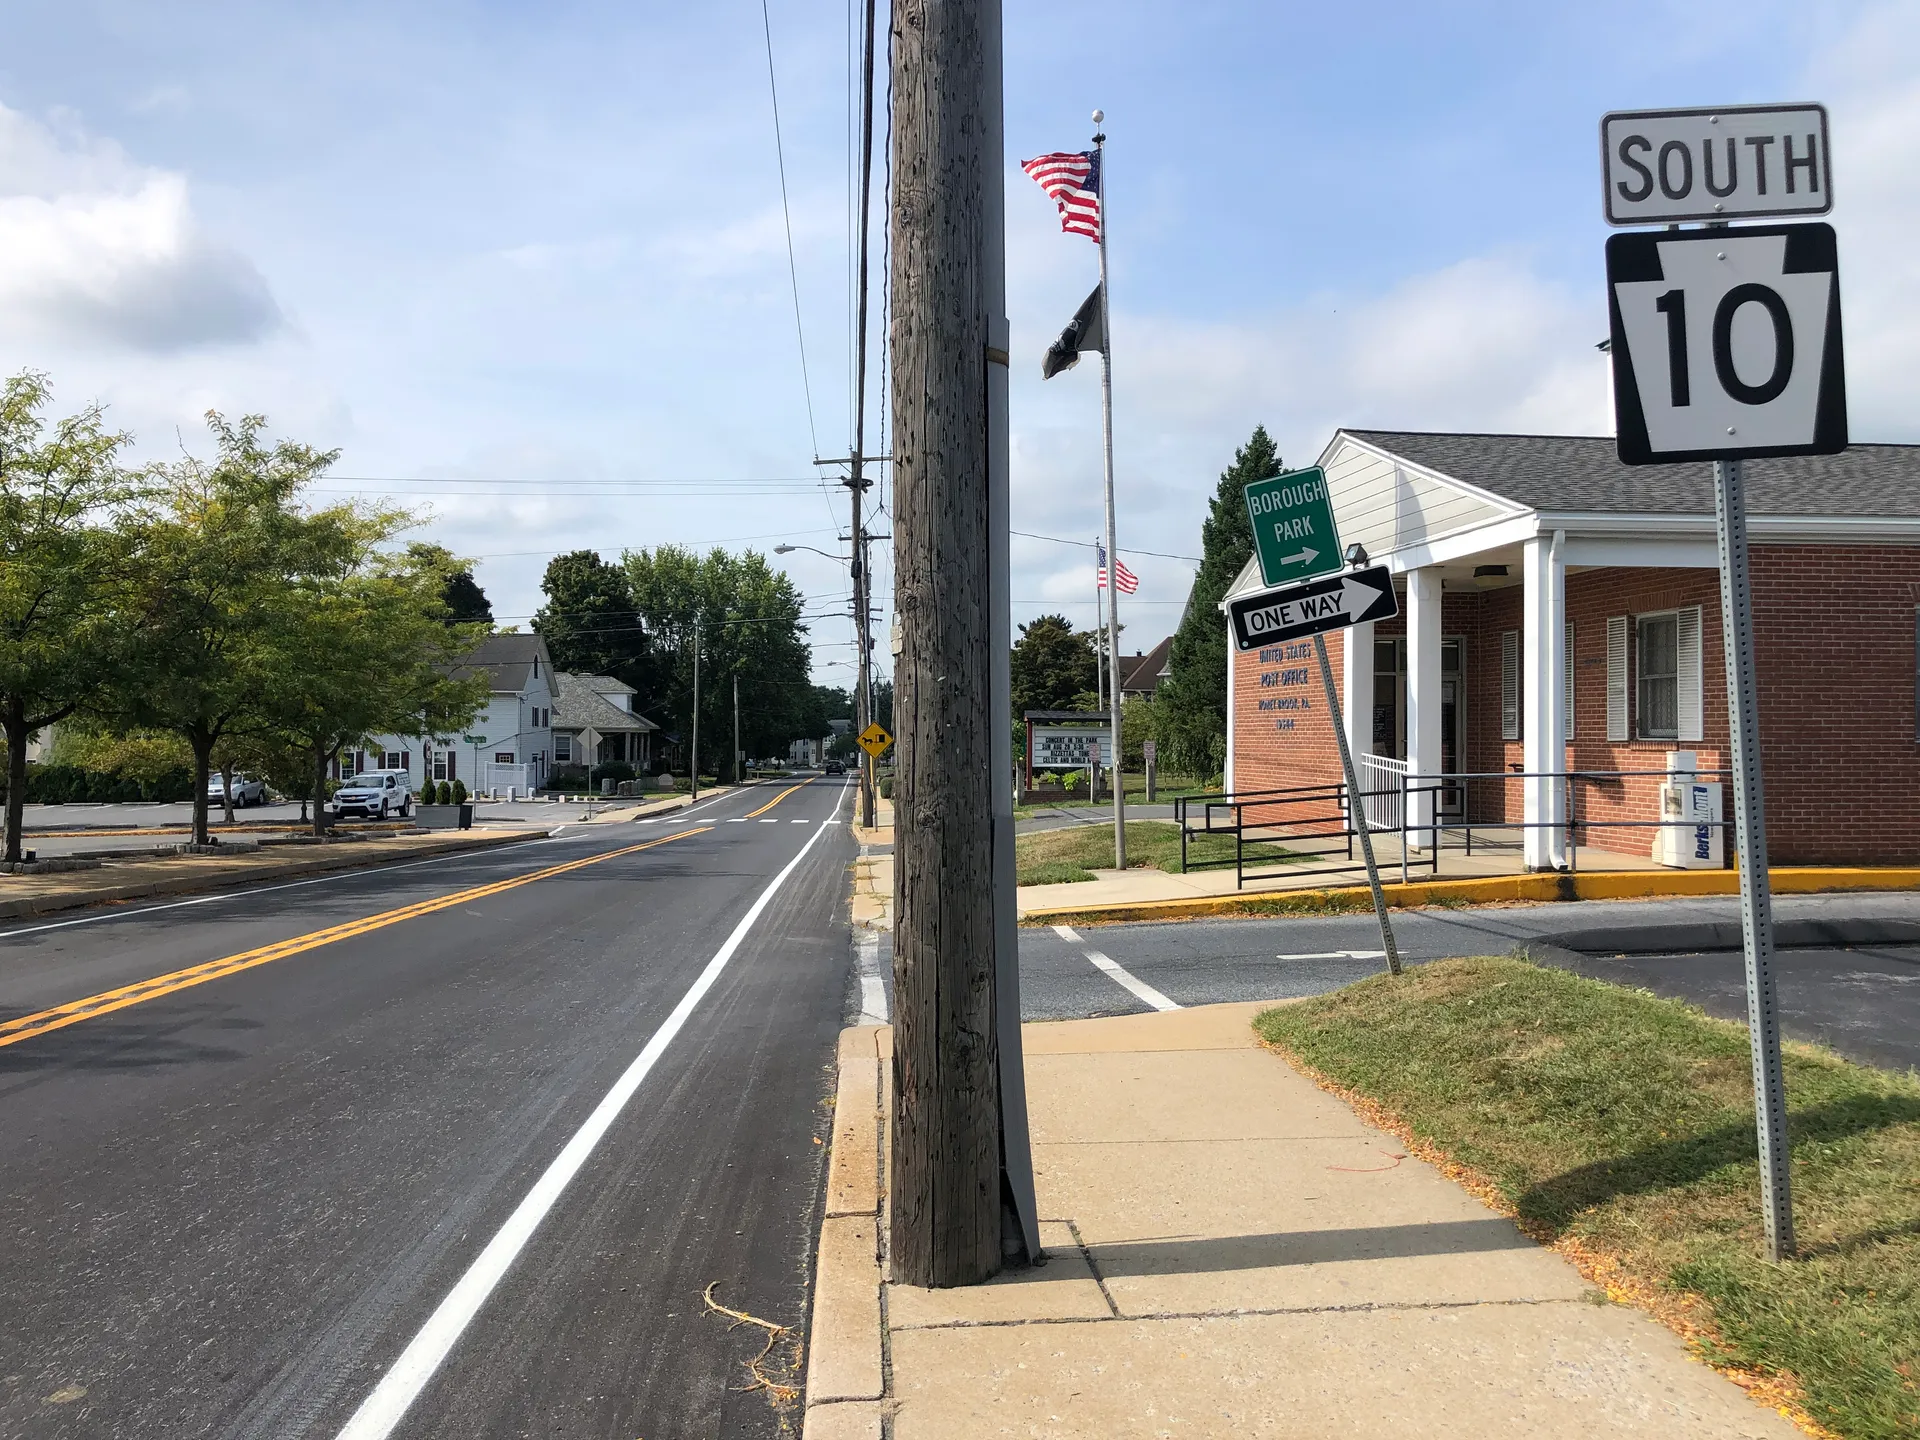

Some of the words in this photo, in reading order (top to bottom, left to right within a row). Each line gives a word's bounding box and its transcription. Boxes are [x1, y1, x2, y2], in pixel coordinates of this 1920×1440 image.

[1616, 133, 1819, 202] SOUTH
[1655, 283, 1794, 407] 10
[1250, 480, 1325, 516] BOROUGH
[1273, 515, 1315, 543] PARK
[1250, 604, 1295, 632] ONE
[1300, 591, 1343, 620] WAY
[1259, 647, 1283, 663] UNITED
[1286, 642, 1311, 660] STATES
[1261, 671, 1279, 687] POST
[1282, 667, 1308, 686] OFFICE
[1045, 736, 1065, 744] CONCERT
[1068, 736, 1073, 744] IN
[1075, 736, 1083, 744] THE
[1085, 736, 1098, 744] PARK
